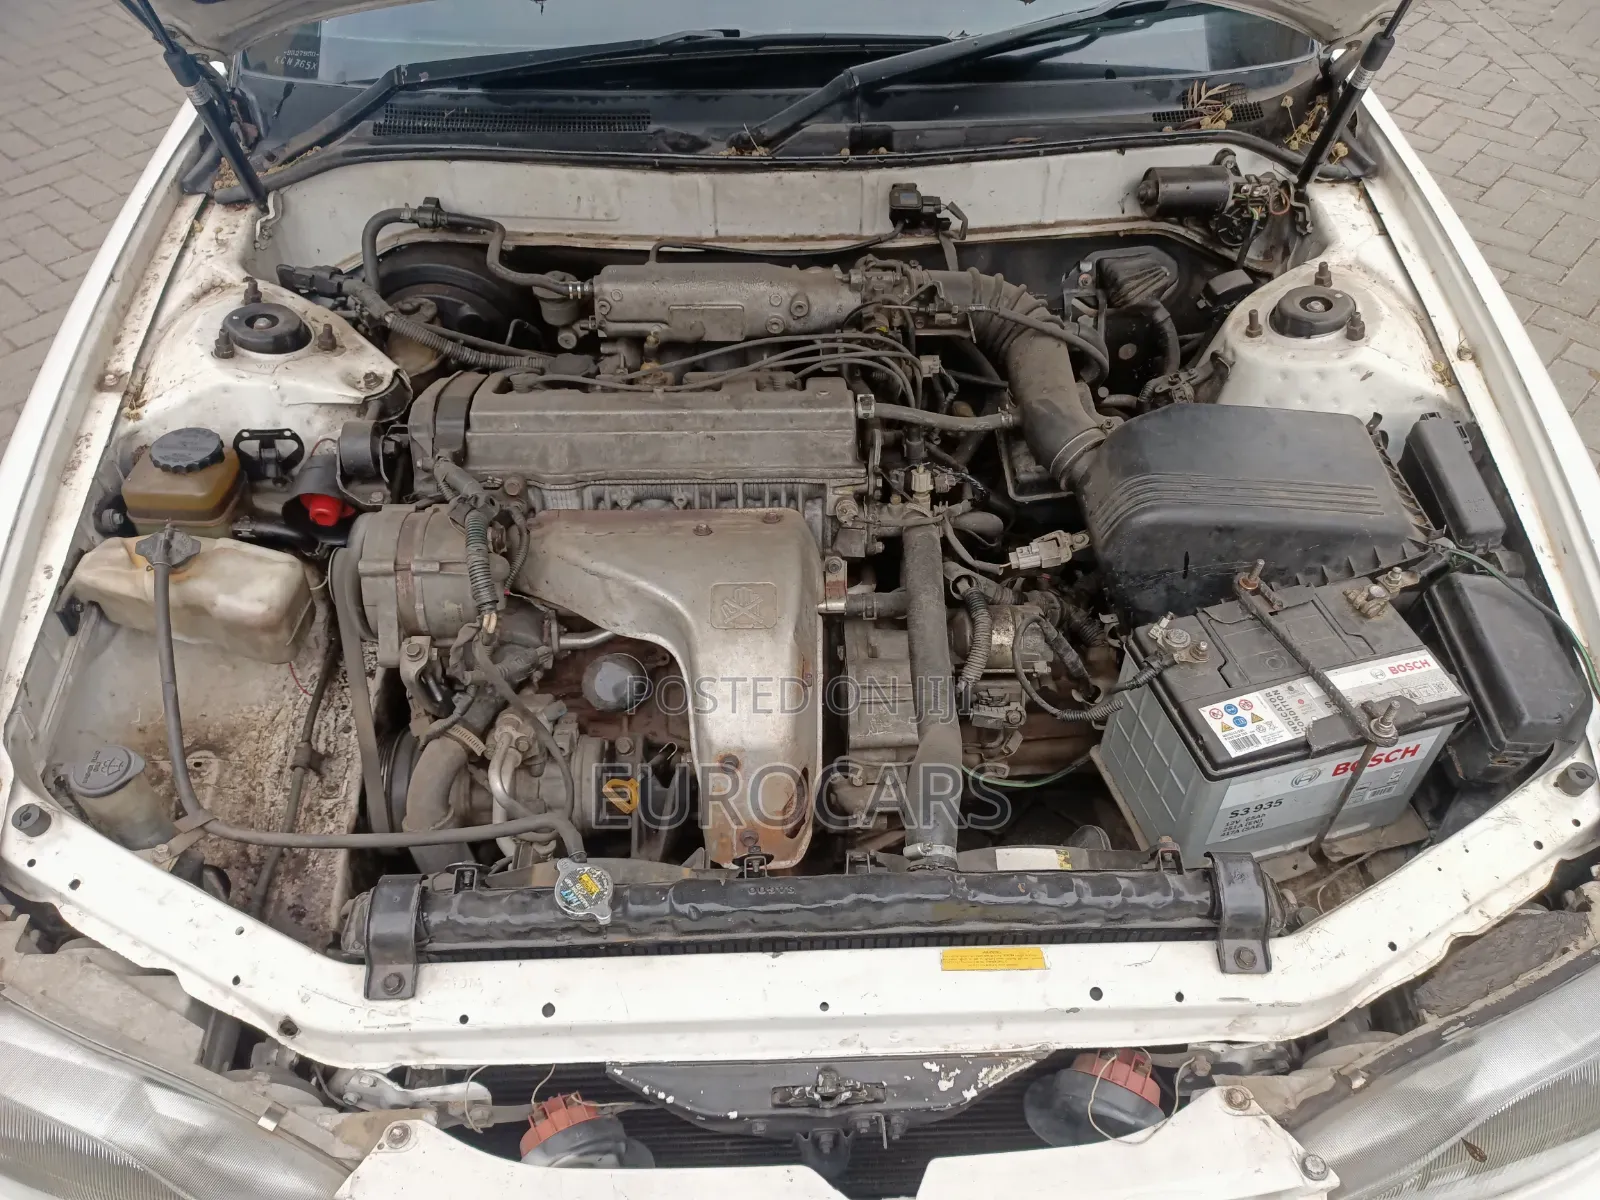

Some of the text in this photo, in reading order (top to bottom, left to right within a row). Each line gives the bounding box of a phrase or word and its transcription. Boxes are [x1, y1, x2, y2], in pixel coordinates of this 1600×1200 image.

[274, 55, 317, 70] KCN 765X
[1388, 659, 1431, 675] BOSCH
[1266, 692, 1302, 735] INDICATOR
[1272, 690, 1307, 731] CONDITION
[1228, 798, 1284, 819] S3 935
